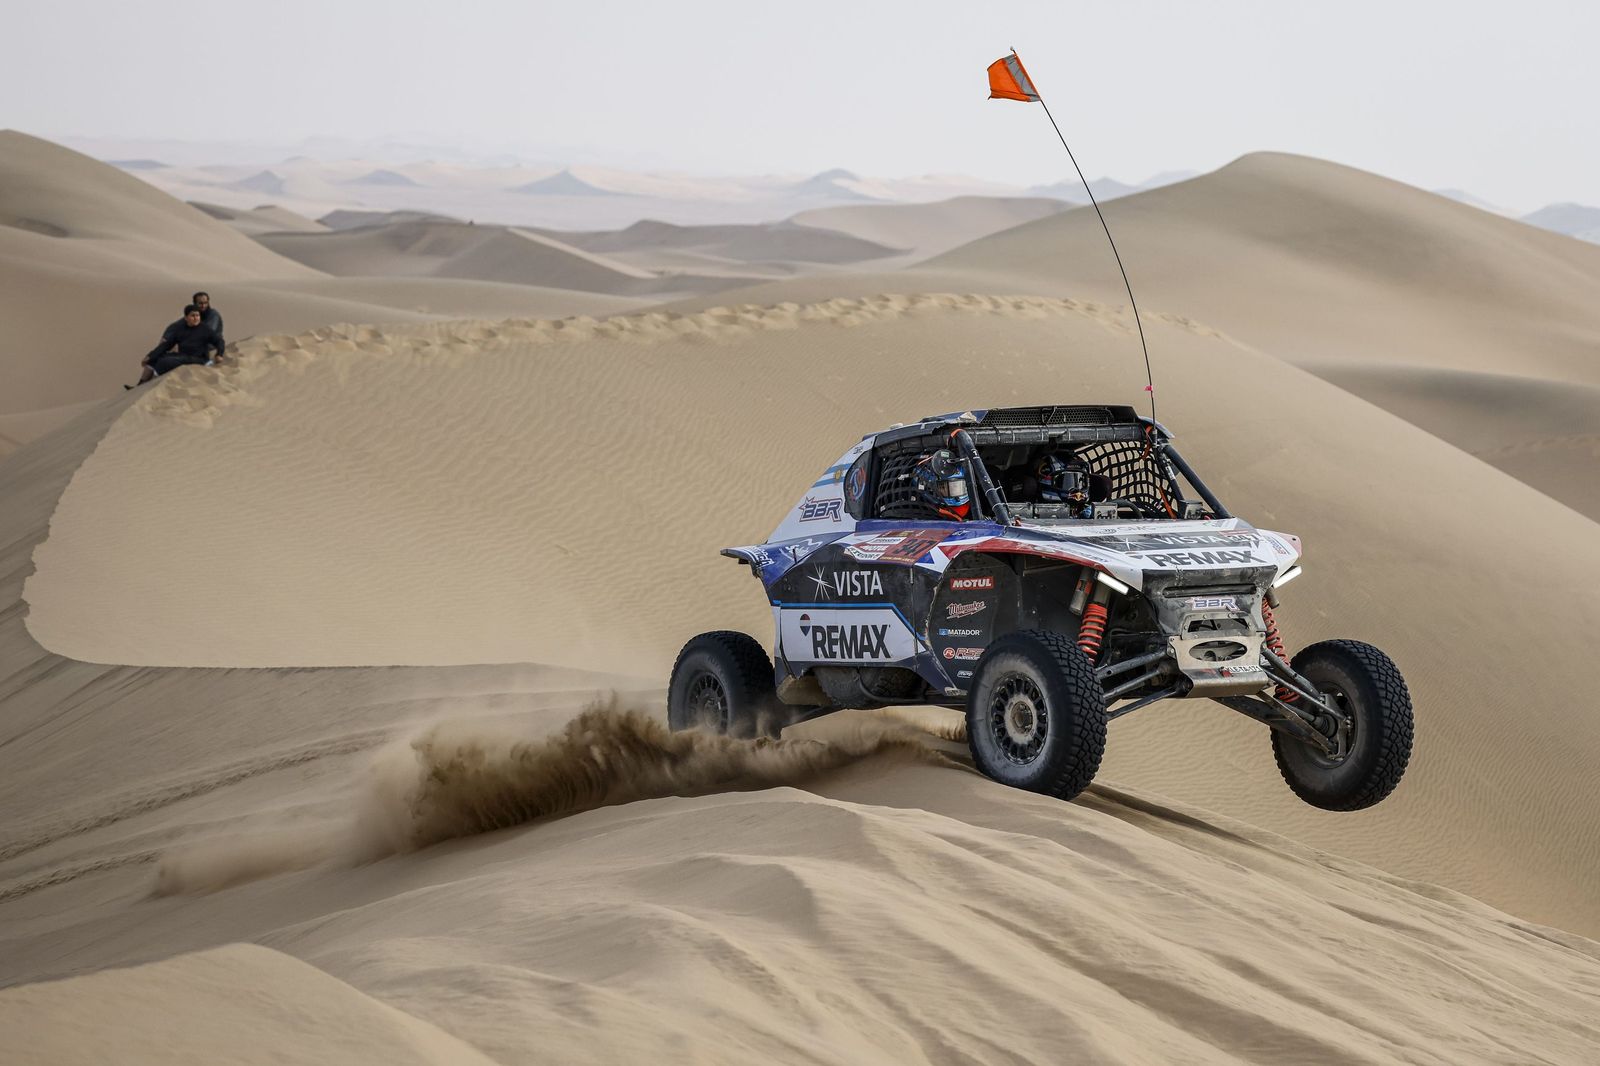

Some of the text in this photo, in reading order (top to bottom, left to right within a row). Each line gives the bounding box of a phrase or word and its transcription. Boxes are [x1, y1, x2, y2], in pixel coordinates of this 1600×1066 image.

[801, 499, 841, 521] BBR
[1153, 534, 1230, 546] VISTA
[1145, 550, 1267, 567] REMAX
[833, 570, 884, 596] VISTA
[952, 578, 992, 588] MOTUL
[946, 601, 987, 617] Milwaukee
[1193, 597, 1239, 610] BBR
[812, 624, 891, 659] REMAX
